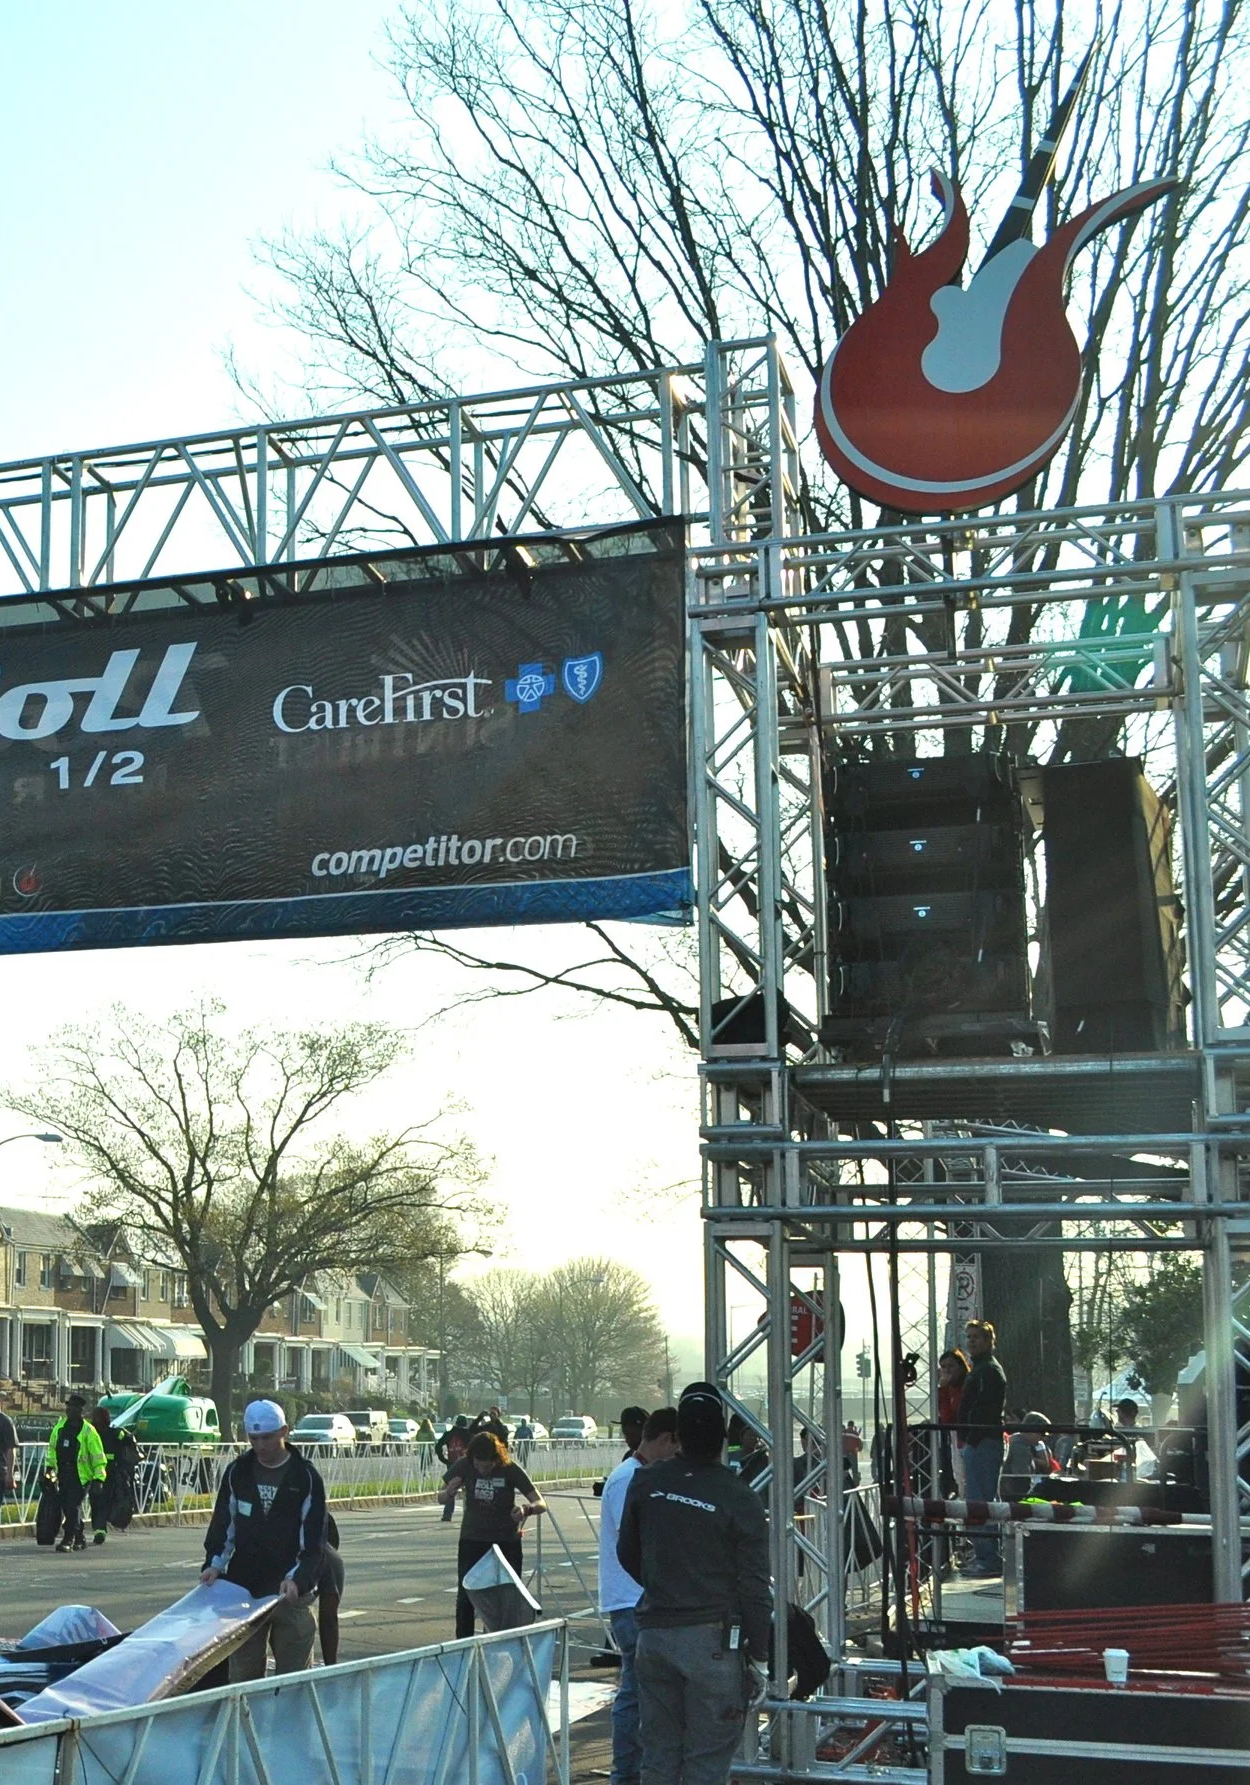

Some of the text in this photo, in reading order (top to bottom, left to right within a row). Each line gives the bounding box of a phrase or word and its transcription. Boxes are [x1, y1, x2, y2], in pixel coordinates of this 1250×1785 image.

[272, 669, 493, 734] CareFirst
[49, 749, 146, 791] 1/2
[311, 831, 579, 878] competitor.com
[666, 1492, 717, 1512] BROOKS
